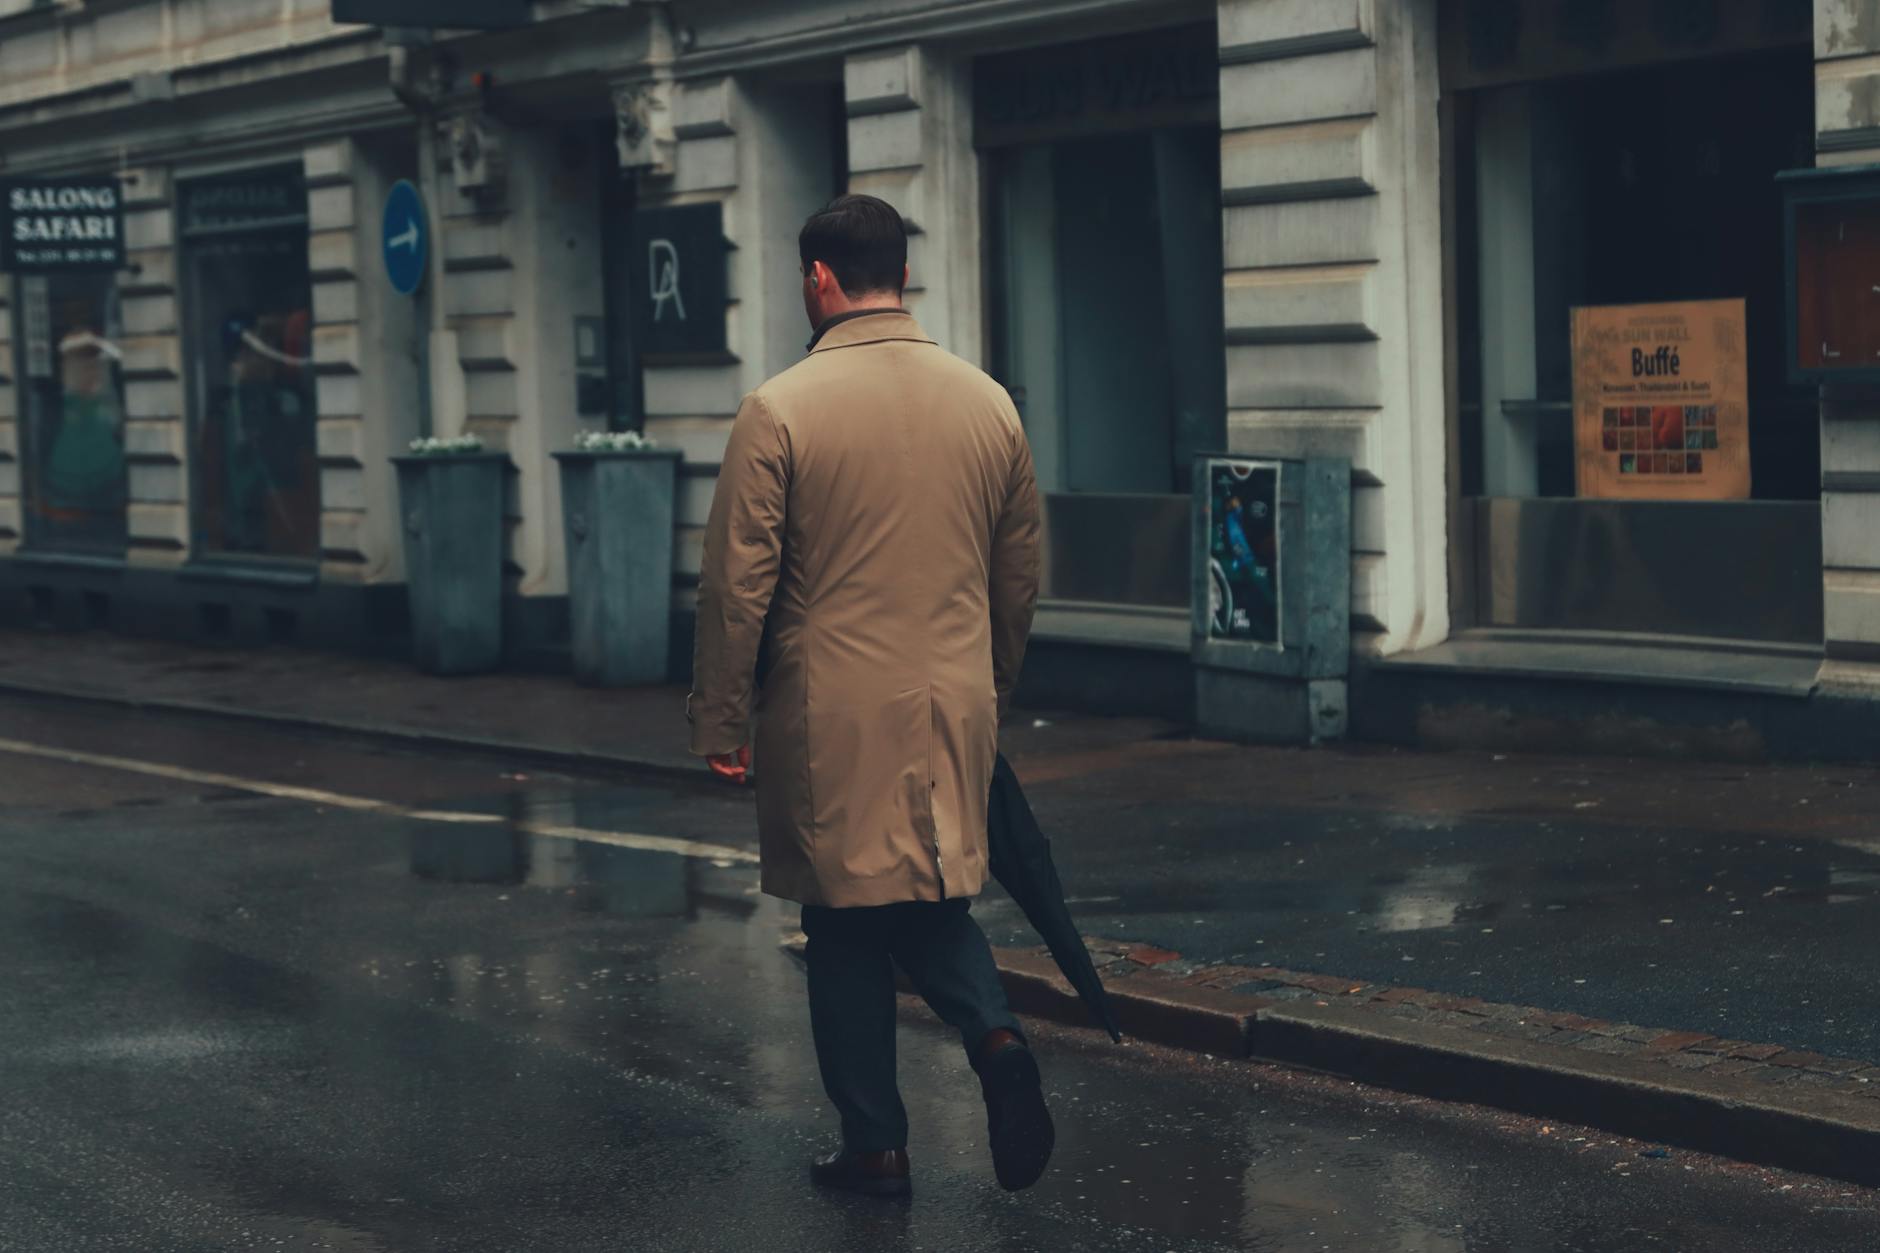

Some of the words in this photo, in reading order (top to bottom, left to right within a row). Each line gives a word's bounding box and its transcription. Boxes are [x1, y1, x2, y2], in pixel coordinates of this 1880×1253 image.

[10, 186, 116, 210] SALONG
[14, 216, 115, 241] SAFARI
[1654, 326, 1692, 342] WALL
[1631, 345, 1680, 377] Buffé
